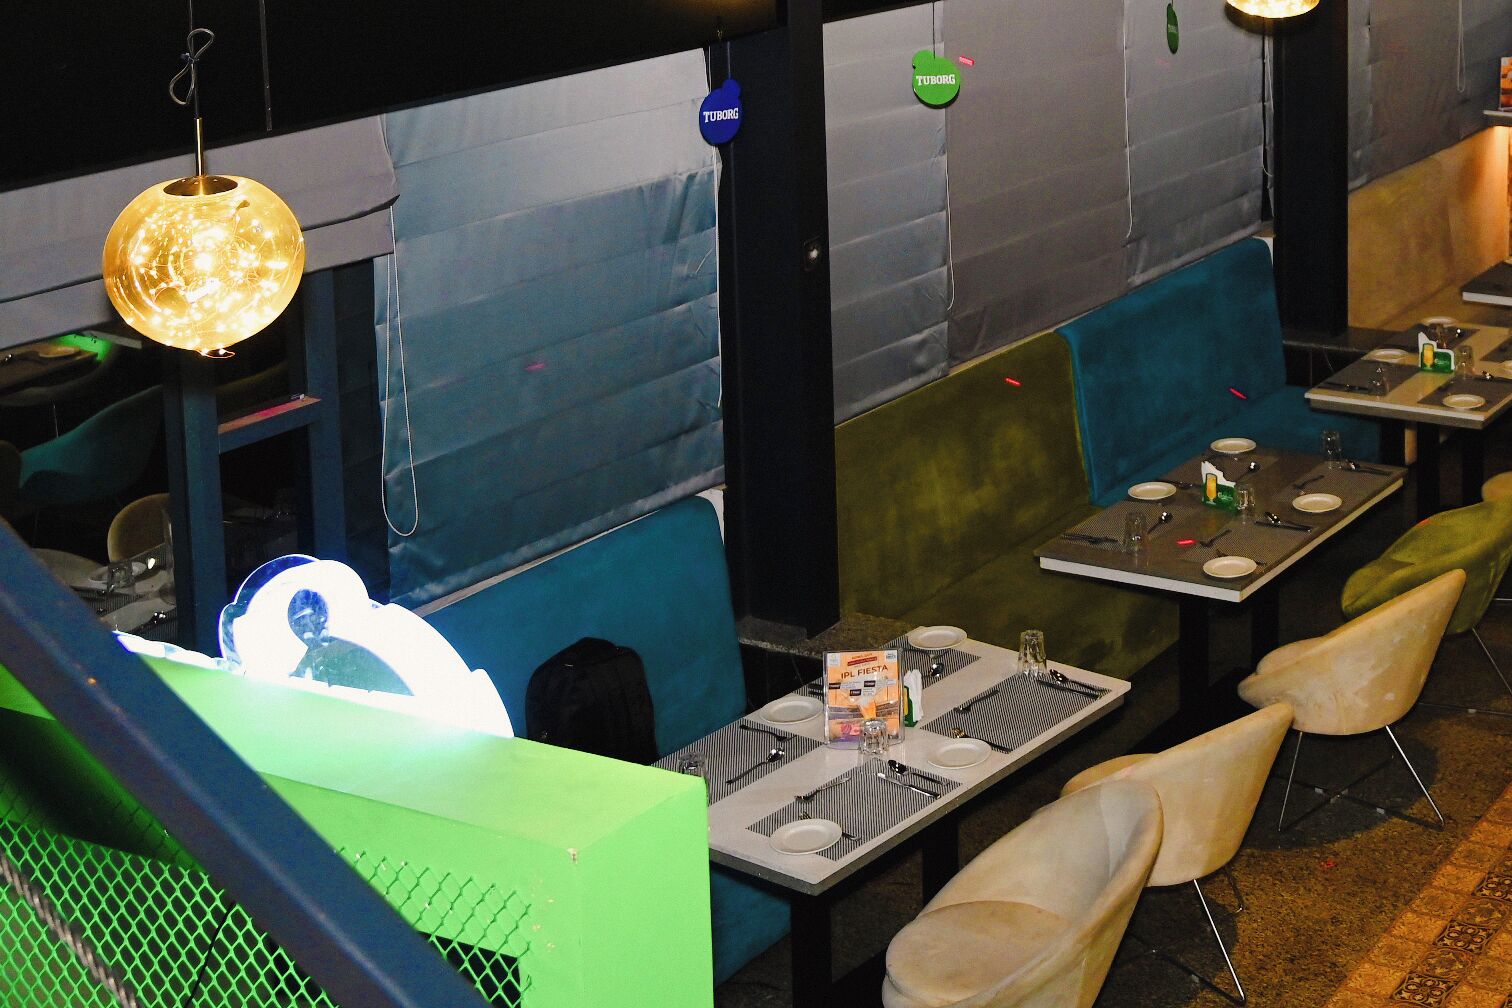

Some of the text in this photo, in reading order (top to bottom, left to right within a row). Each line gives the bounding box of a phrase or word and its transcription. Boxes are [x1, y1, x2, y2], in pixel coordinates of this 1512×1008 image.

[915, 74, 956, 86] TUBORG
[703, 107, 739, 123] TUBORG
[841, 665, 889, 680] IPL FIESTA
